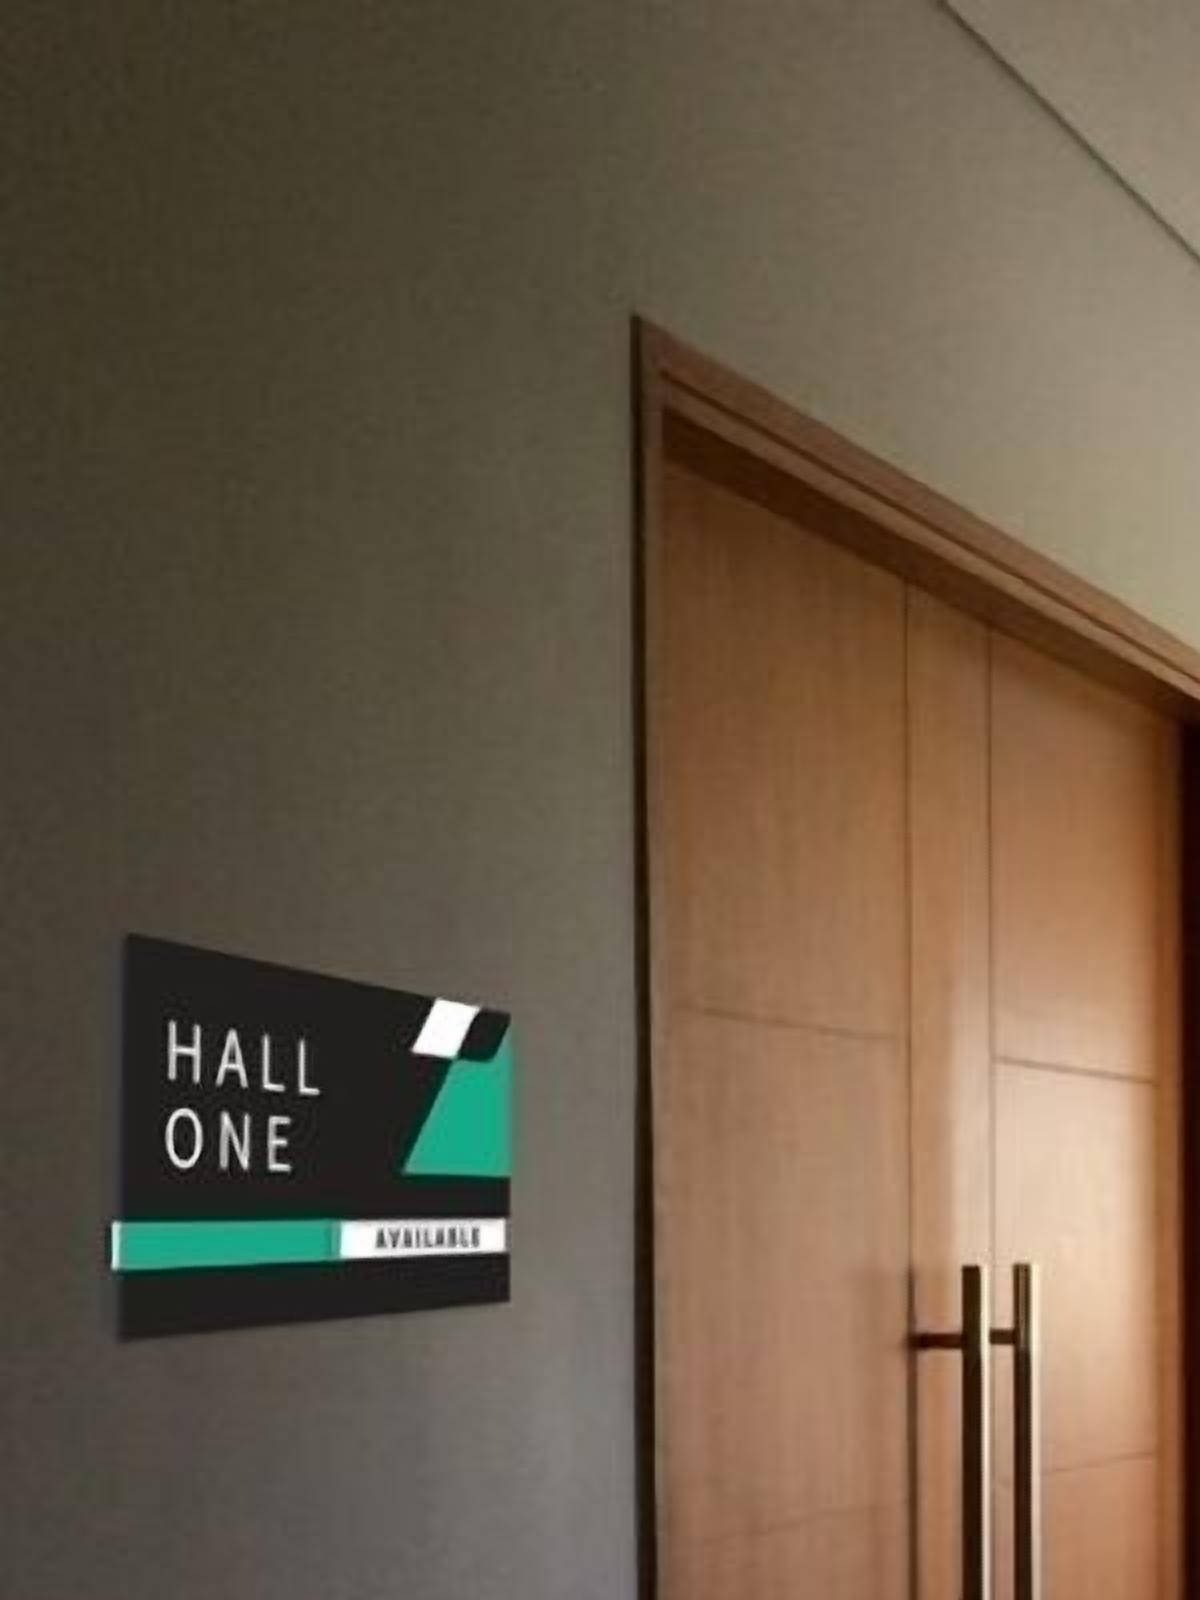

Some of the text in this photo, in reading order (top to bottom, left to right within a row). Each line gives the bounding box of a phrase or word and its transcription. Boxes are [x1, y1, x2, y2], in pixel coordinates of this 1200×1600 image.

[167, 1020, 320, 1096] HALL
[165, 1107, 292, 1172] ONE
[375, 1227, 481, 1249] AVAILABLE
